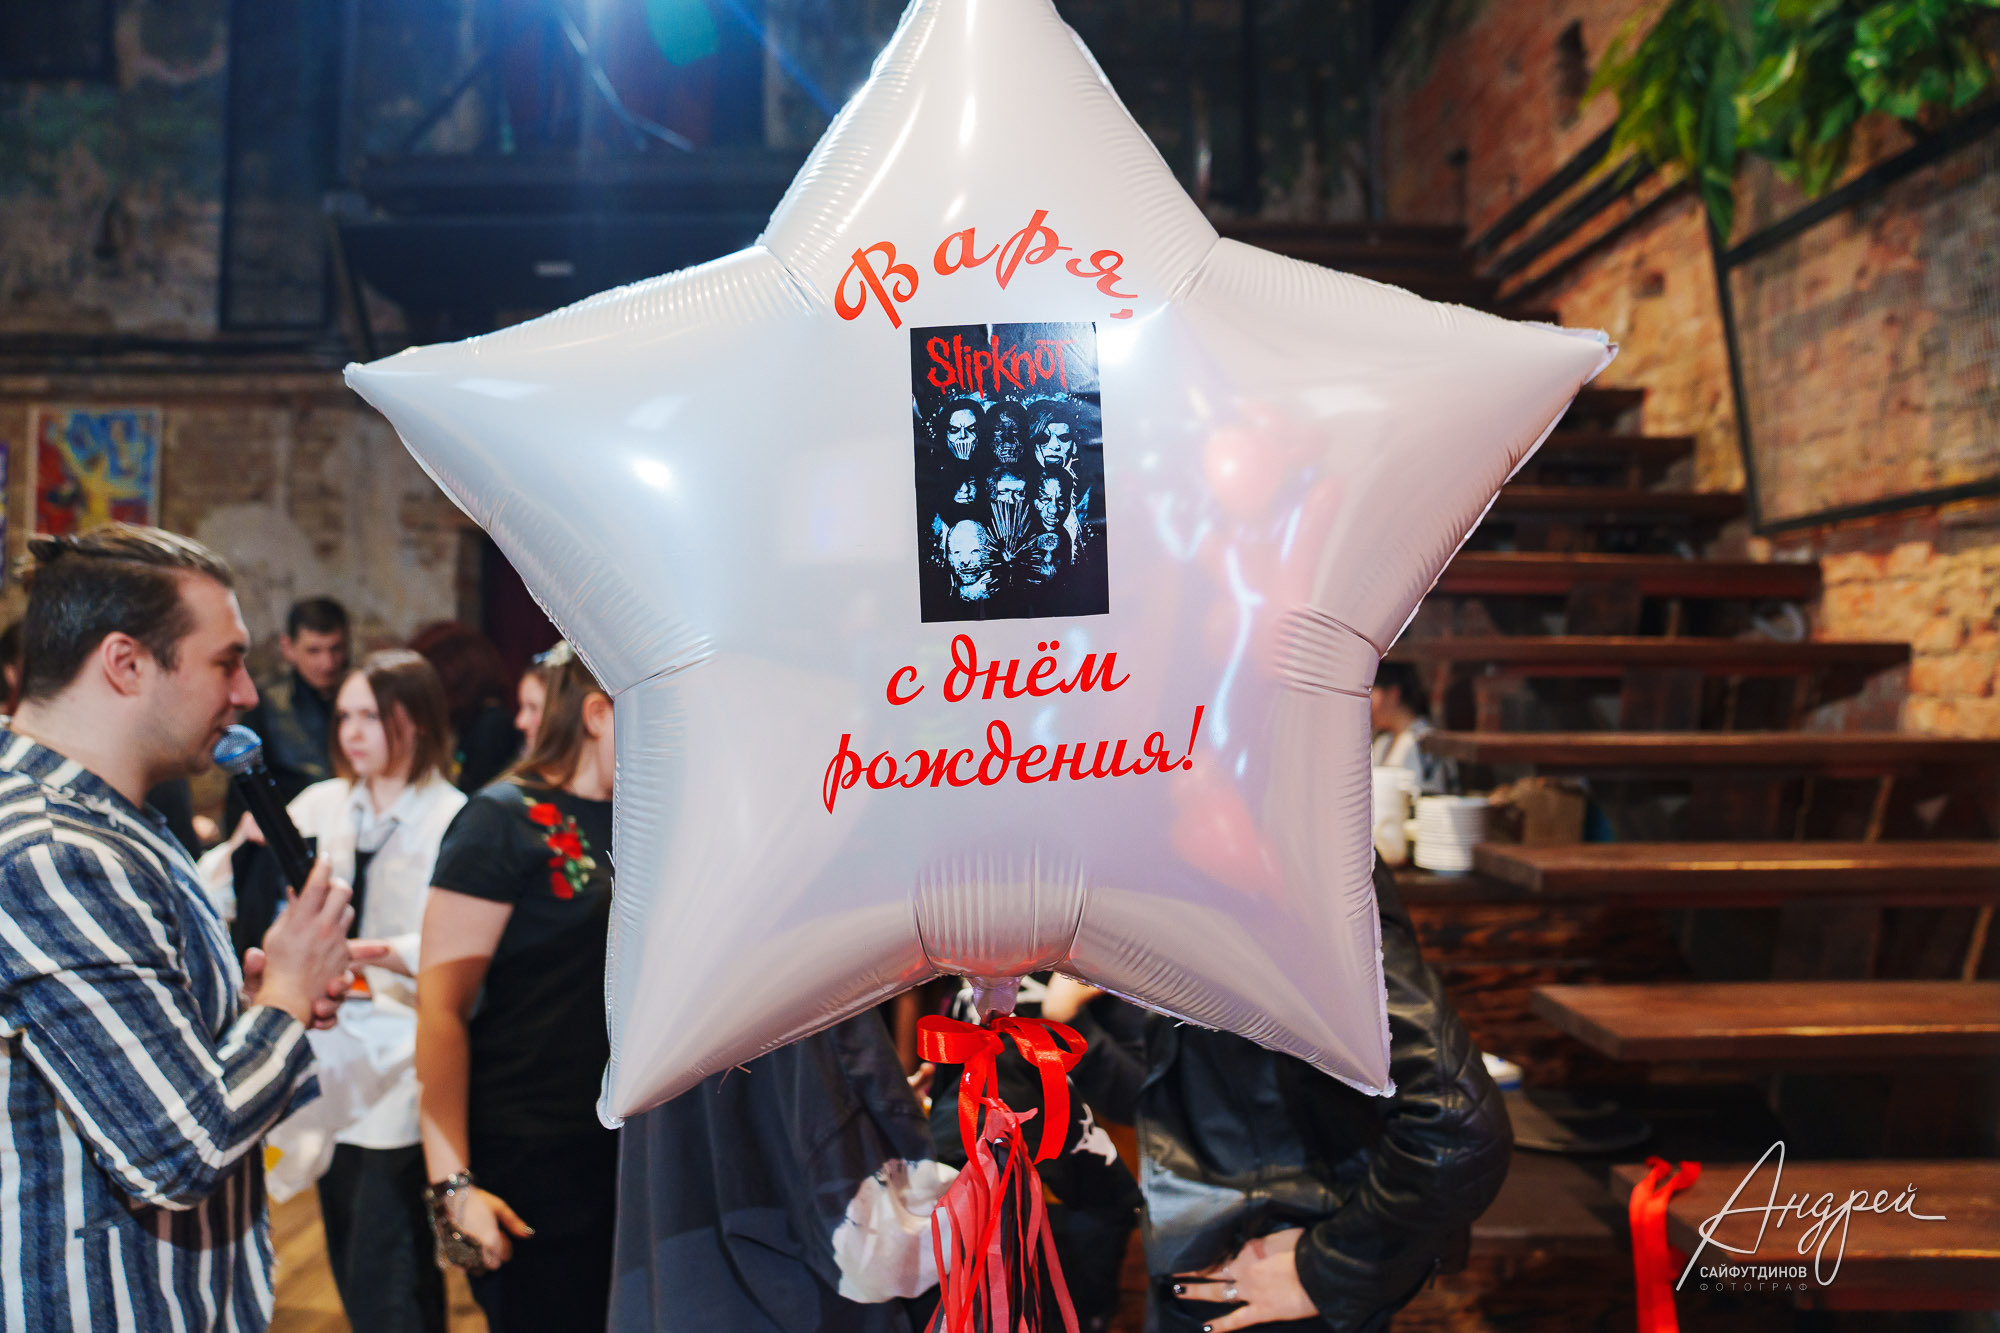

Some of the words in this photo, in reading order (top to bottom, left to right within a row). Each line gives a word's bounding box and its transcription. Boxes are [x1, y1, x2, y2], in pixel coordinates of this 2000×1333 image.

[834, 209, 1138, 330] Варя,
[886, 665, 925, 706] с
[943, 633, 1131, 703] днём
[822, 705, 1205, 815] рождения!
